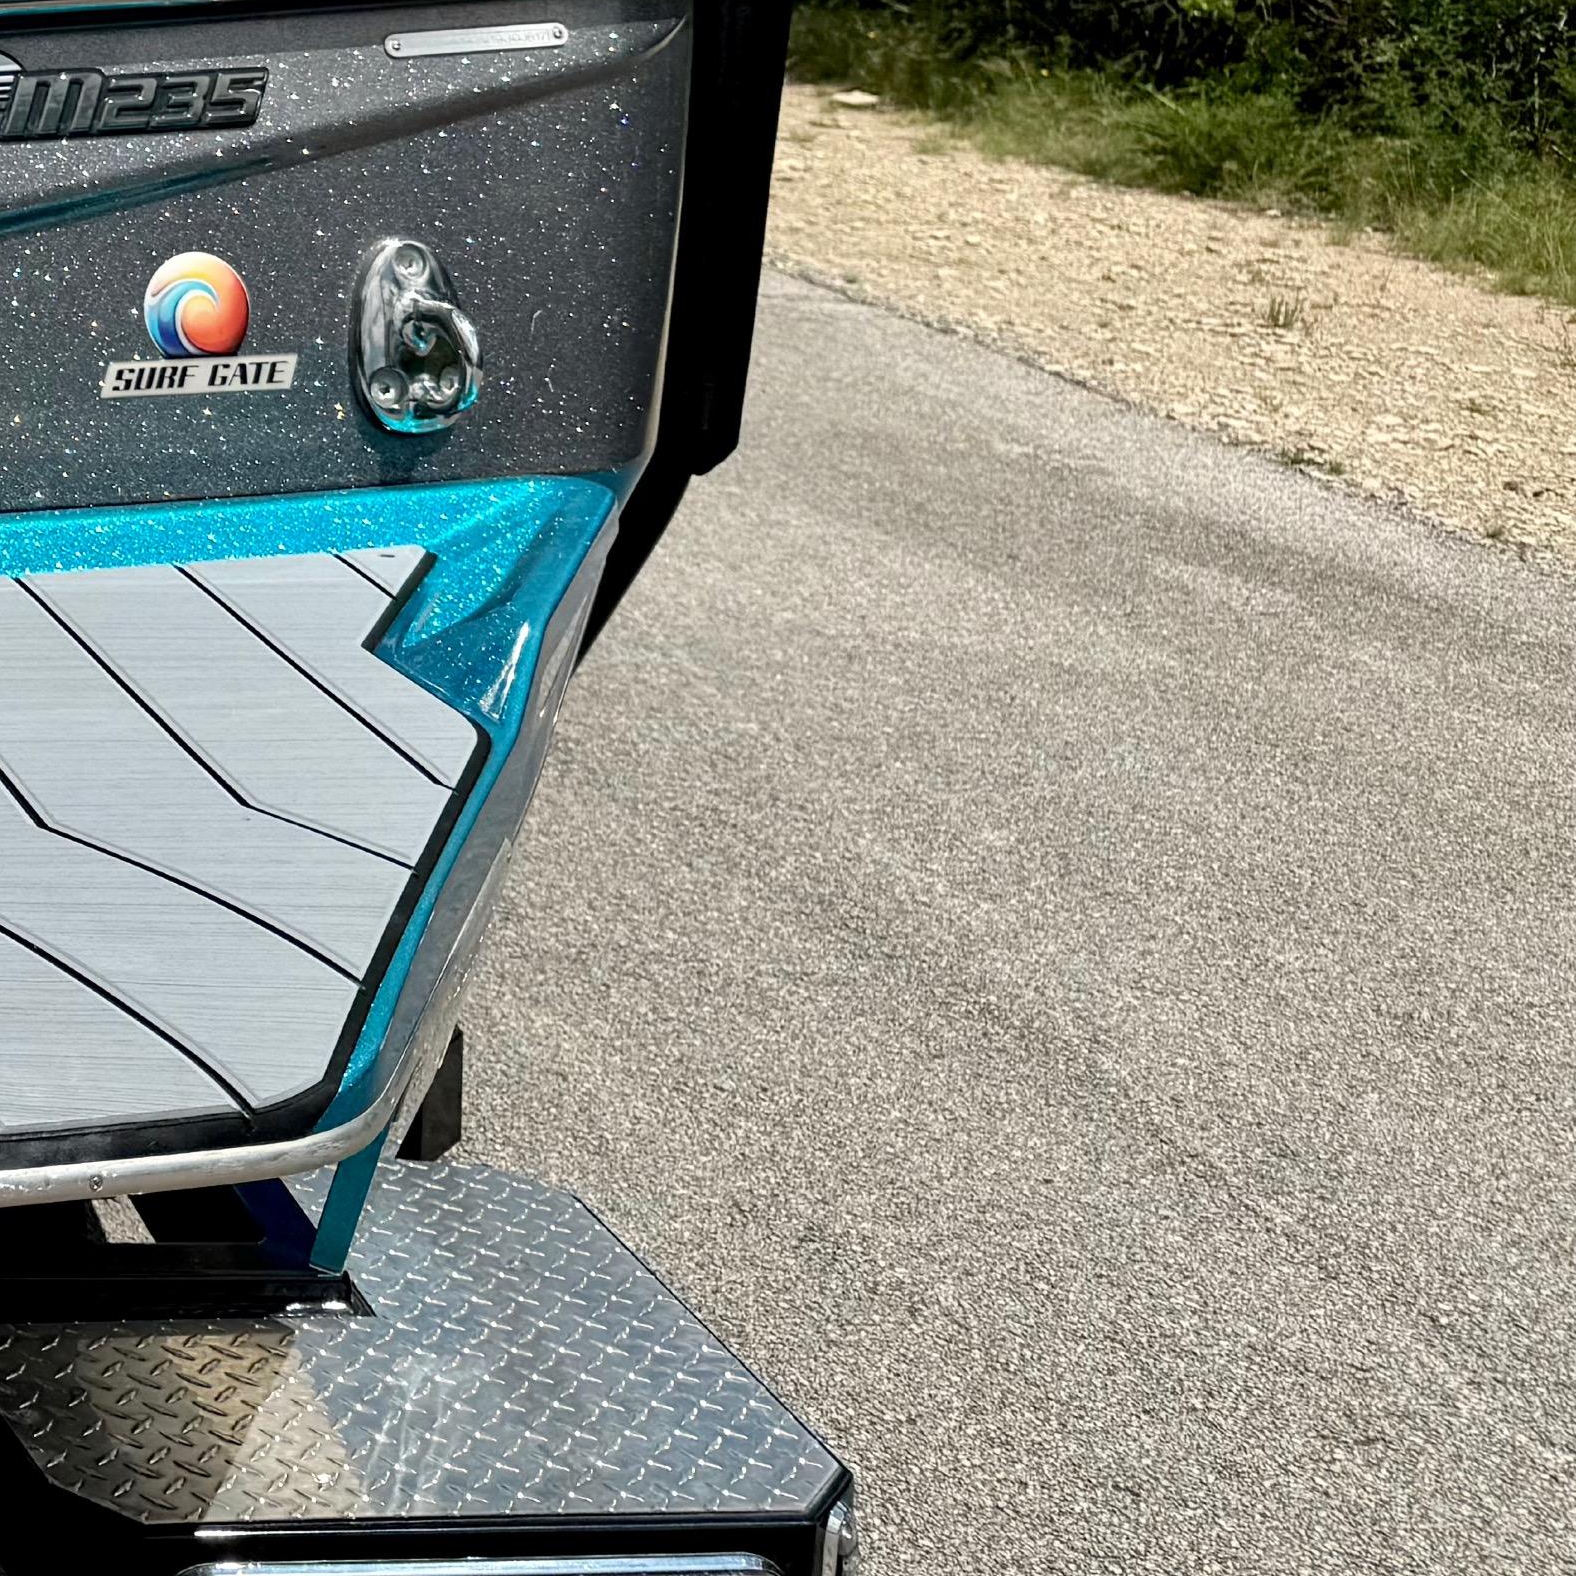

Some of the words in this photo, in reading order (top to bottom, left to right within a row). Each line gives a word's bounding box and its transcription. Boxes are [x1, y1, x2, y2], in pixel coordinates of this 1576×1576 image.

[1, 67, 268, 139] M235
[111, 364, 198, 391] SURF
[207, 359, 290, 388] GATE
